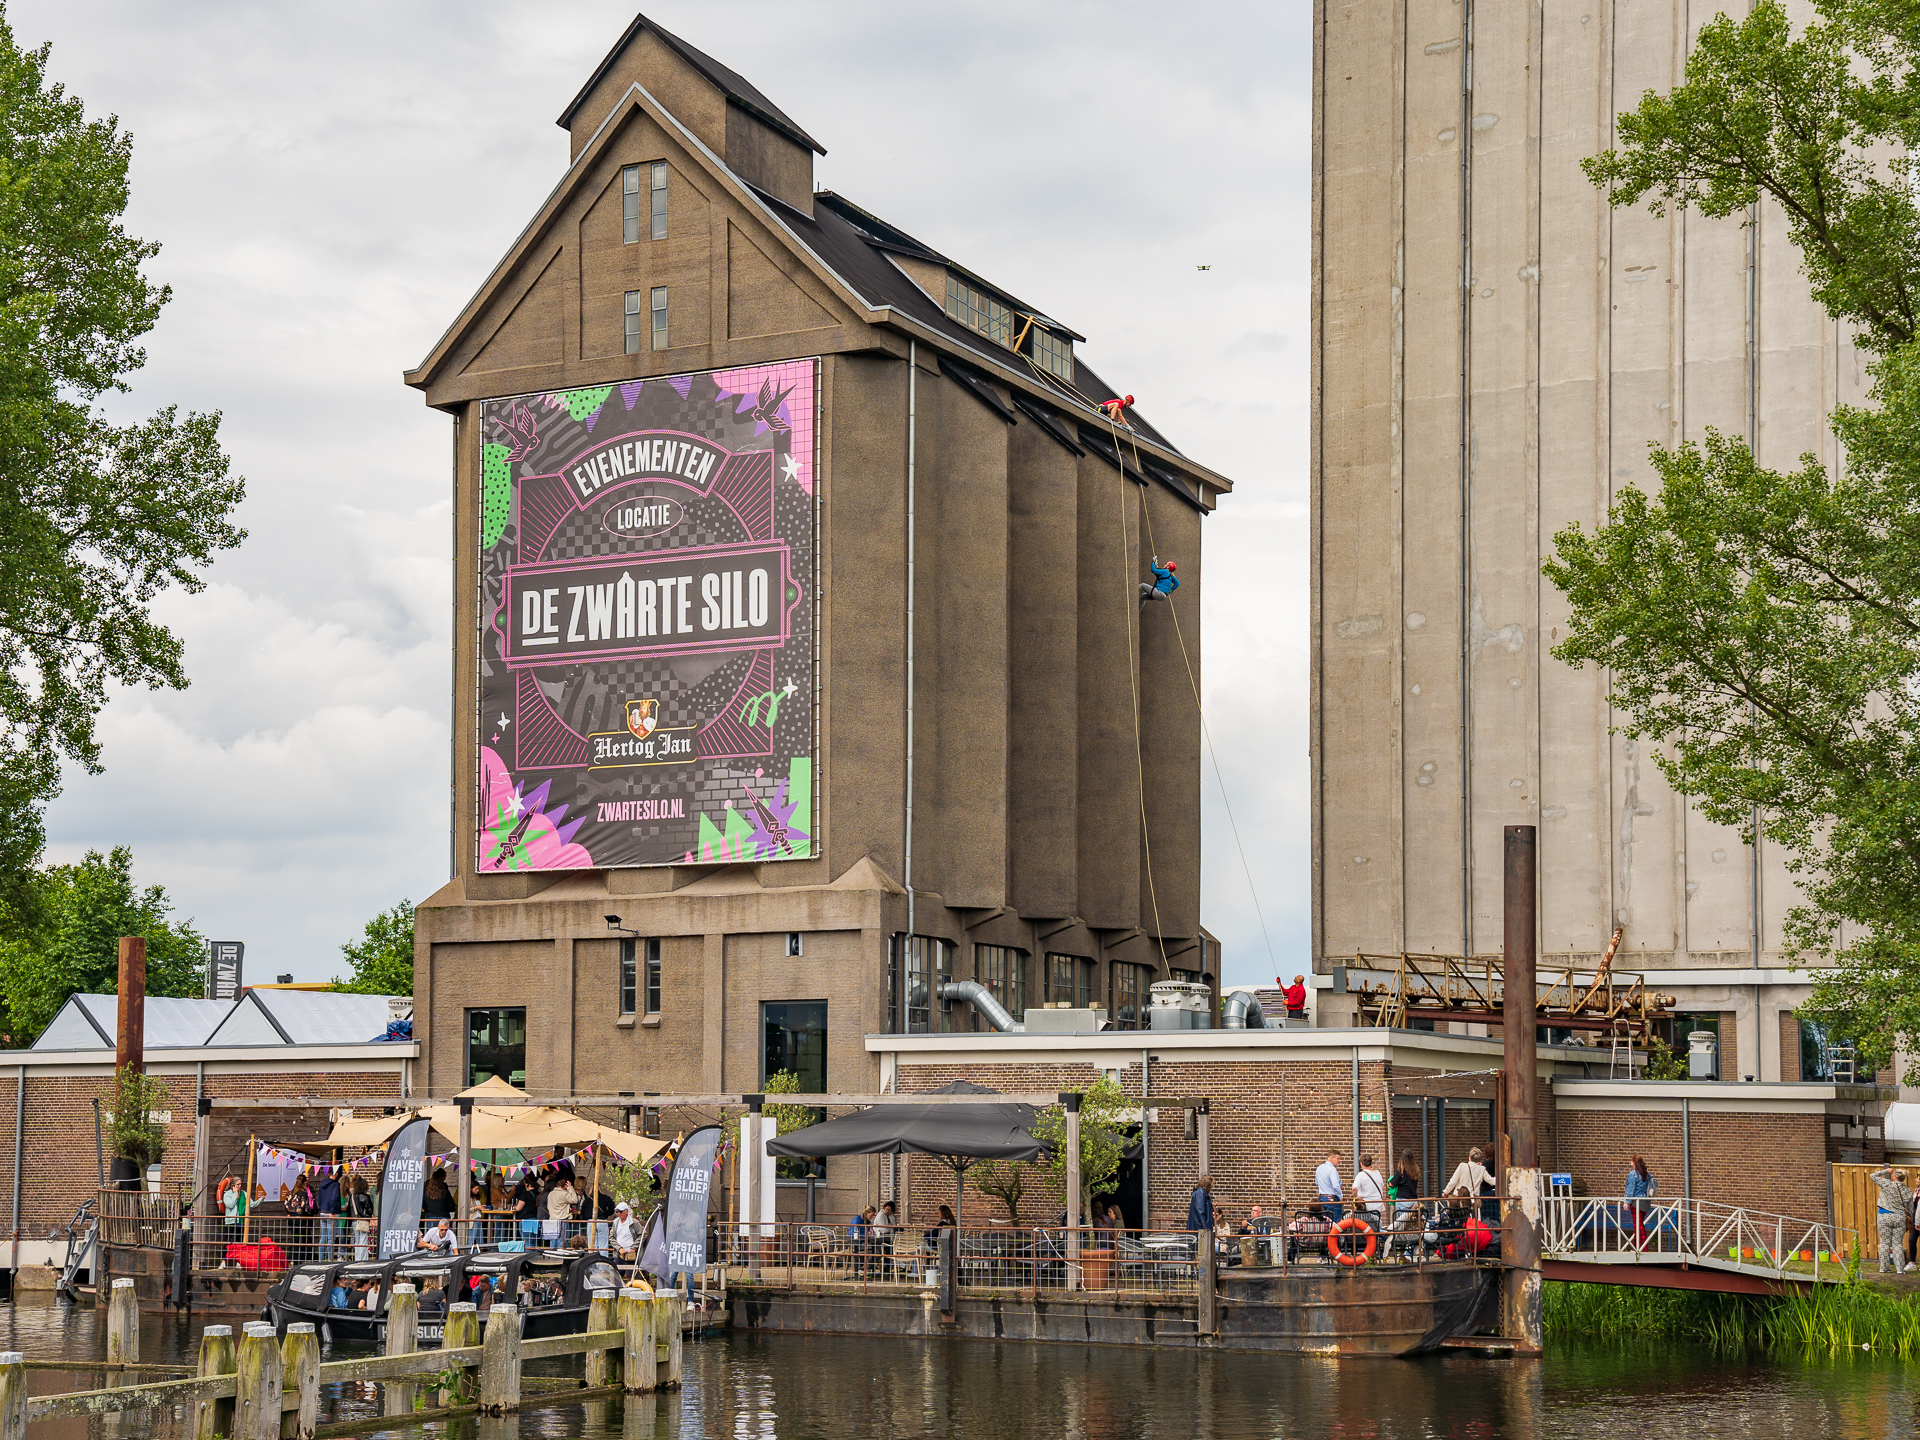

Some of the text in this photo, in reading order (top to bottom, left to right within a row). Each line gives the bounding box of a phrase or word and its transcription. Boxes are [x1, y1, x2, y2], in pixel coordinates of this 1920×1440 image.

[572, 439, 717, 497] EVENEMENTEN
[617, 504, 671, 530] LOCATIE
[522, 588, 560, 635] DE
[701, 568, 769, 631] SILO
[593, 733, 692, 765] Hertog Jan
[597, 798, 686, 822] ZWARTESILO.NL
[221, 945, 238, 961] DE
[389, 1159, 423, 1172] HAVEN
[388, 1171, 423, 1183] SLOEP
[676, 1167, 709, 1182] HAVEN
[674, 1180, 708, 1194] SLOEP
[384, 1230, 418, 1240] OPSTAP
[382, 1239, 416, 1253] PUNT
[669, 1241, 703, 1254] OPSTAP
[668, 1250, 703, 1268] PUNT
